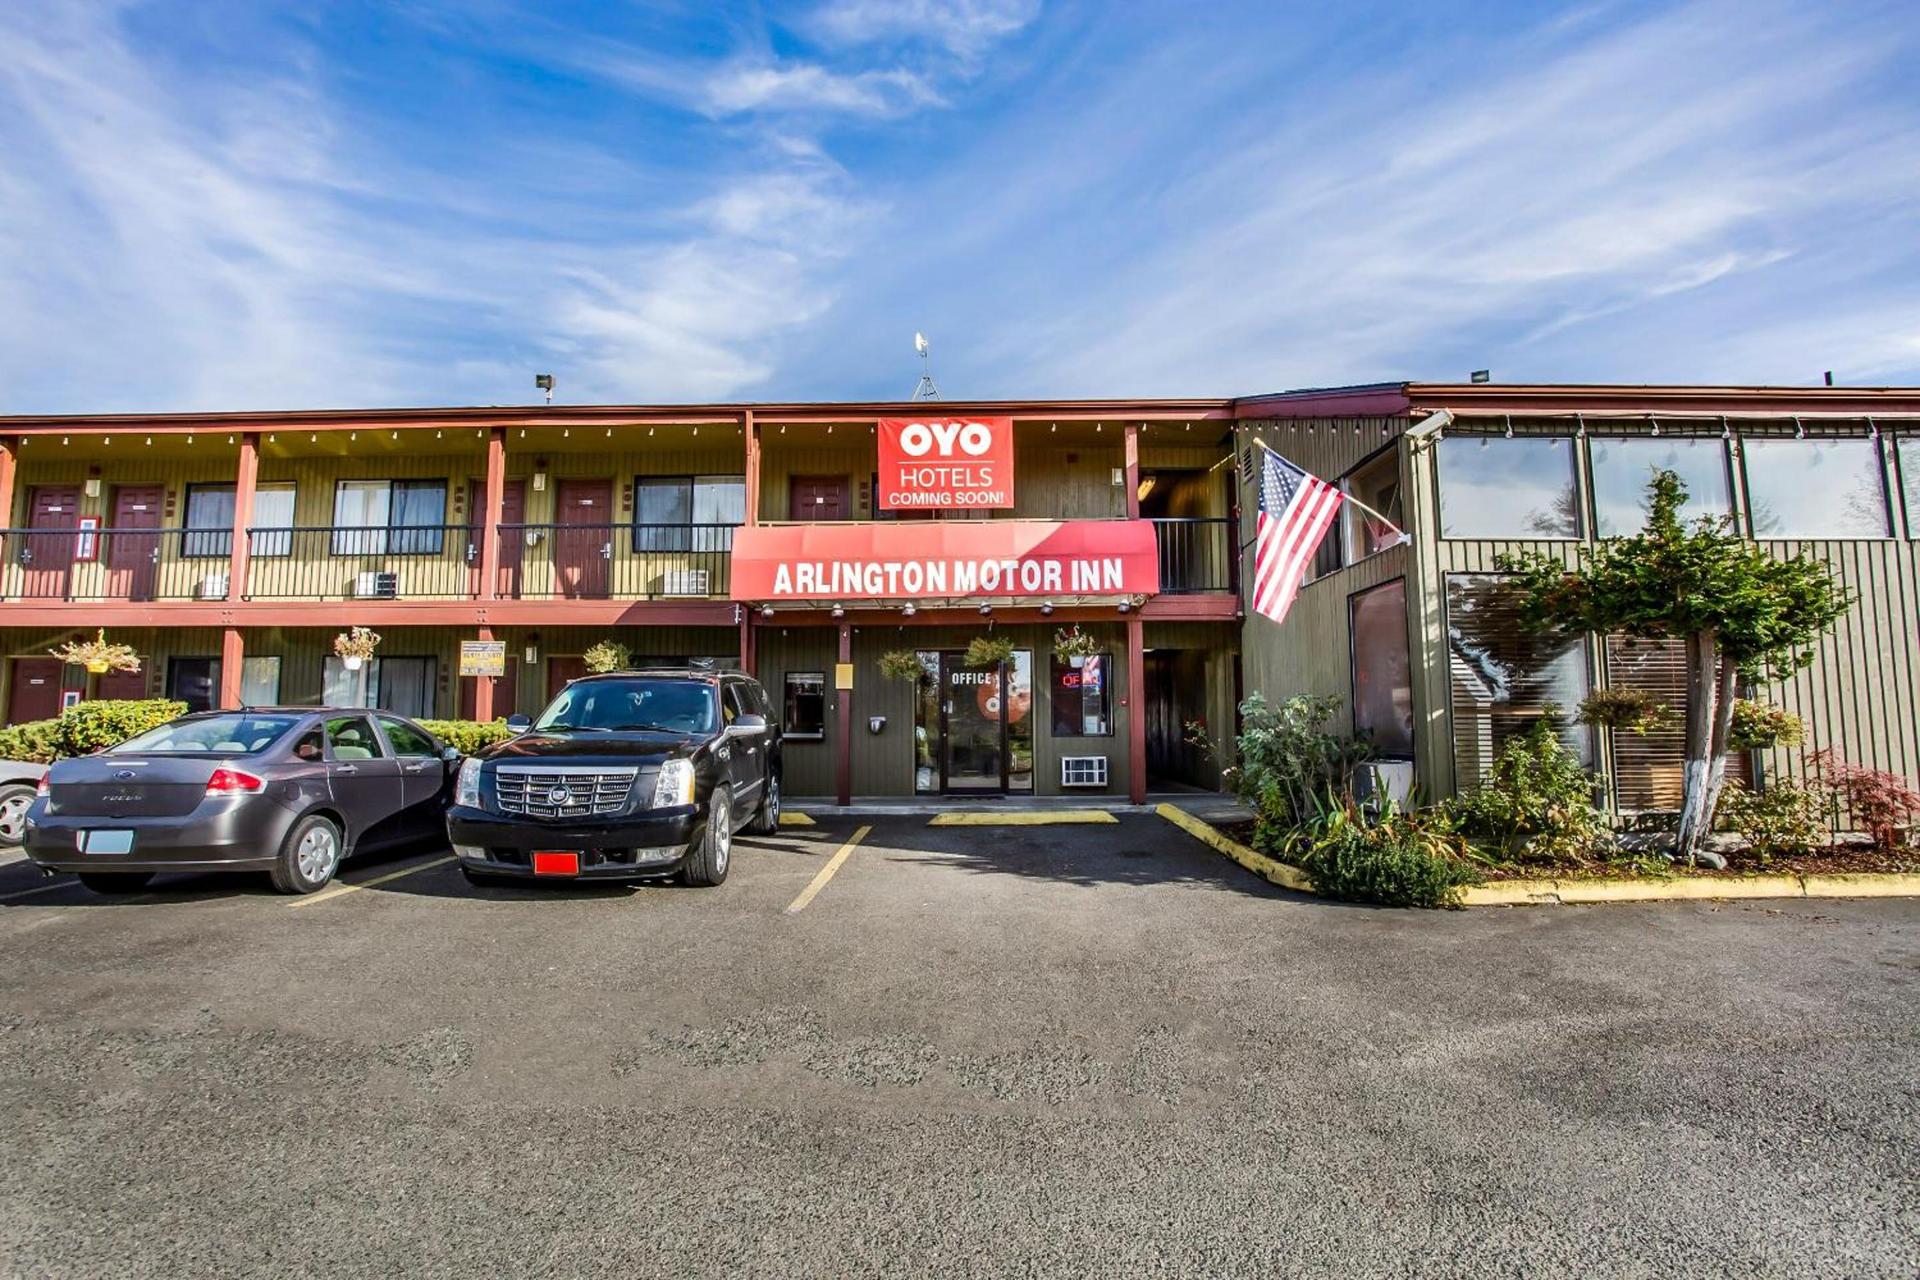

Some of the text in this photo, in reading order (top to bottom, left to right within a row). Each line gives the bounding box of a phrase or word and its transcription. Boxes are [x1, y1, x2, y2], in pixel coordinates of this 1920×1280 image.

[900, 423, 992, 456] OYO
[900, 467, 993, 488] HOTELS
[889, 491, 1004, 505] COMING SOON!
[773, 558, 1123, 595] ARLINGTON MOTOR INN
[952, 672, 992, 685] OFFICE
